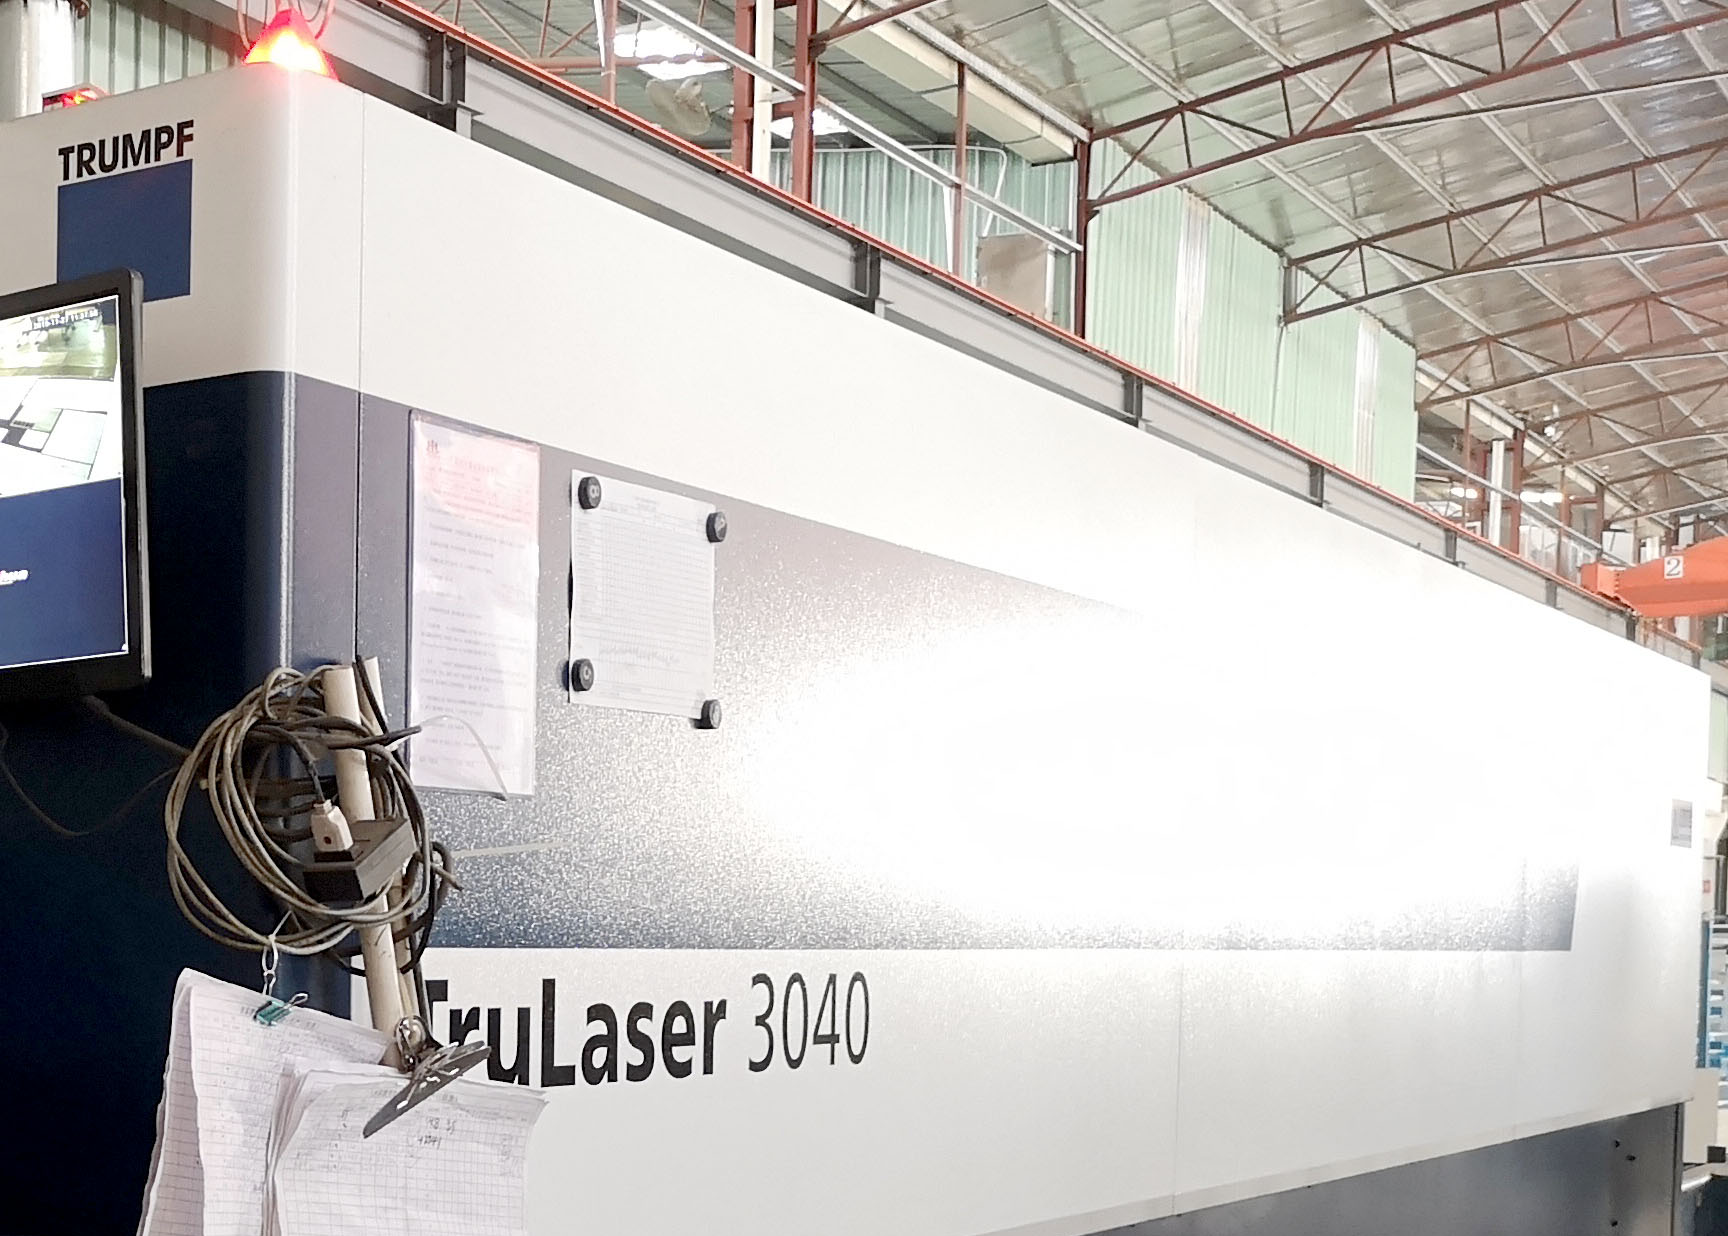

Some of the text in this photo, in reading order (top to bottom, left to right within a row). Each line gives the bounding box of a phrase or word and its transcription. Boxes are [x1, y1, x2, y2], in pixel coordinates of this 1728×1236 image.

[58, 119, 195, 181] TRUMPF
[1666, 557, 1681, 576] 2
[747, 970, 870, 1073] 3040
